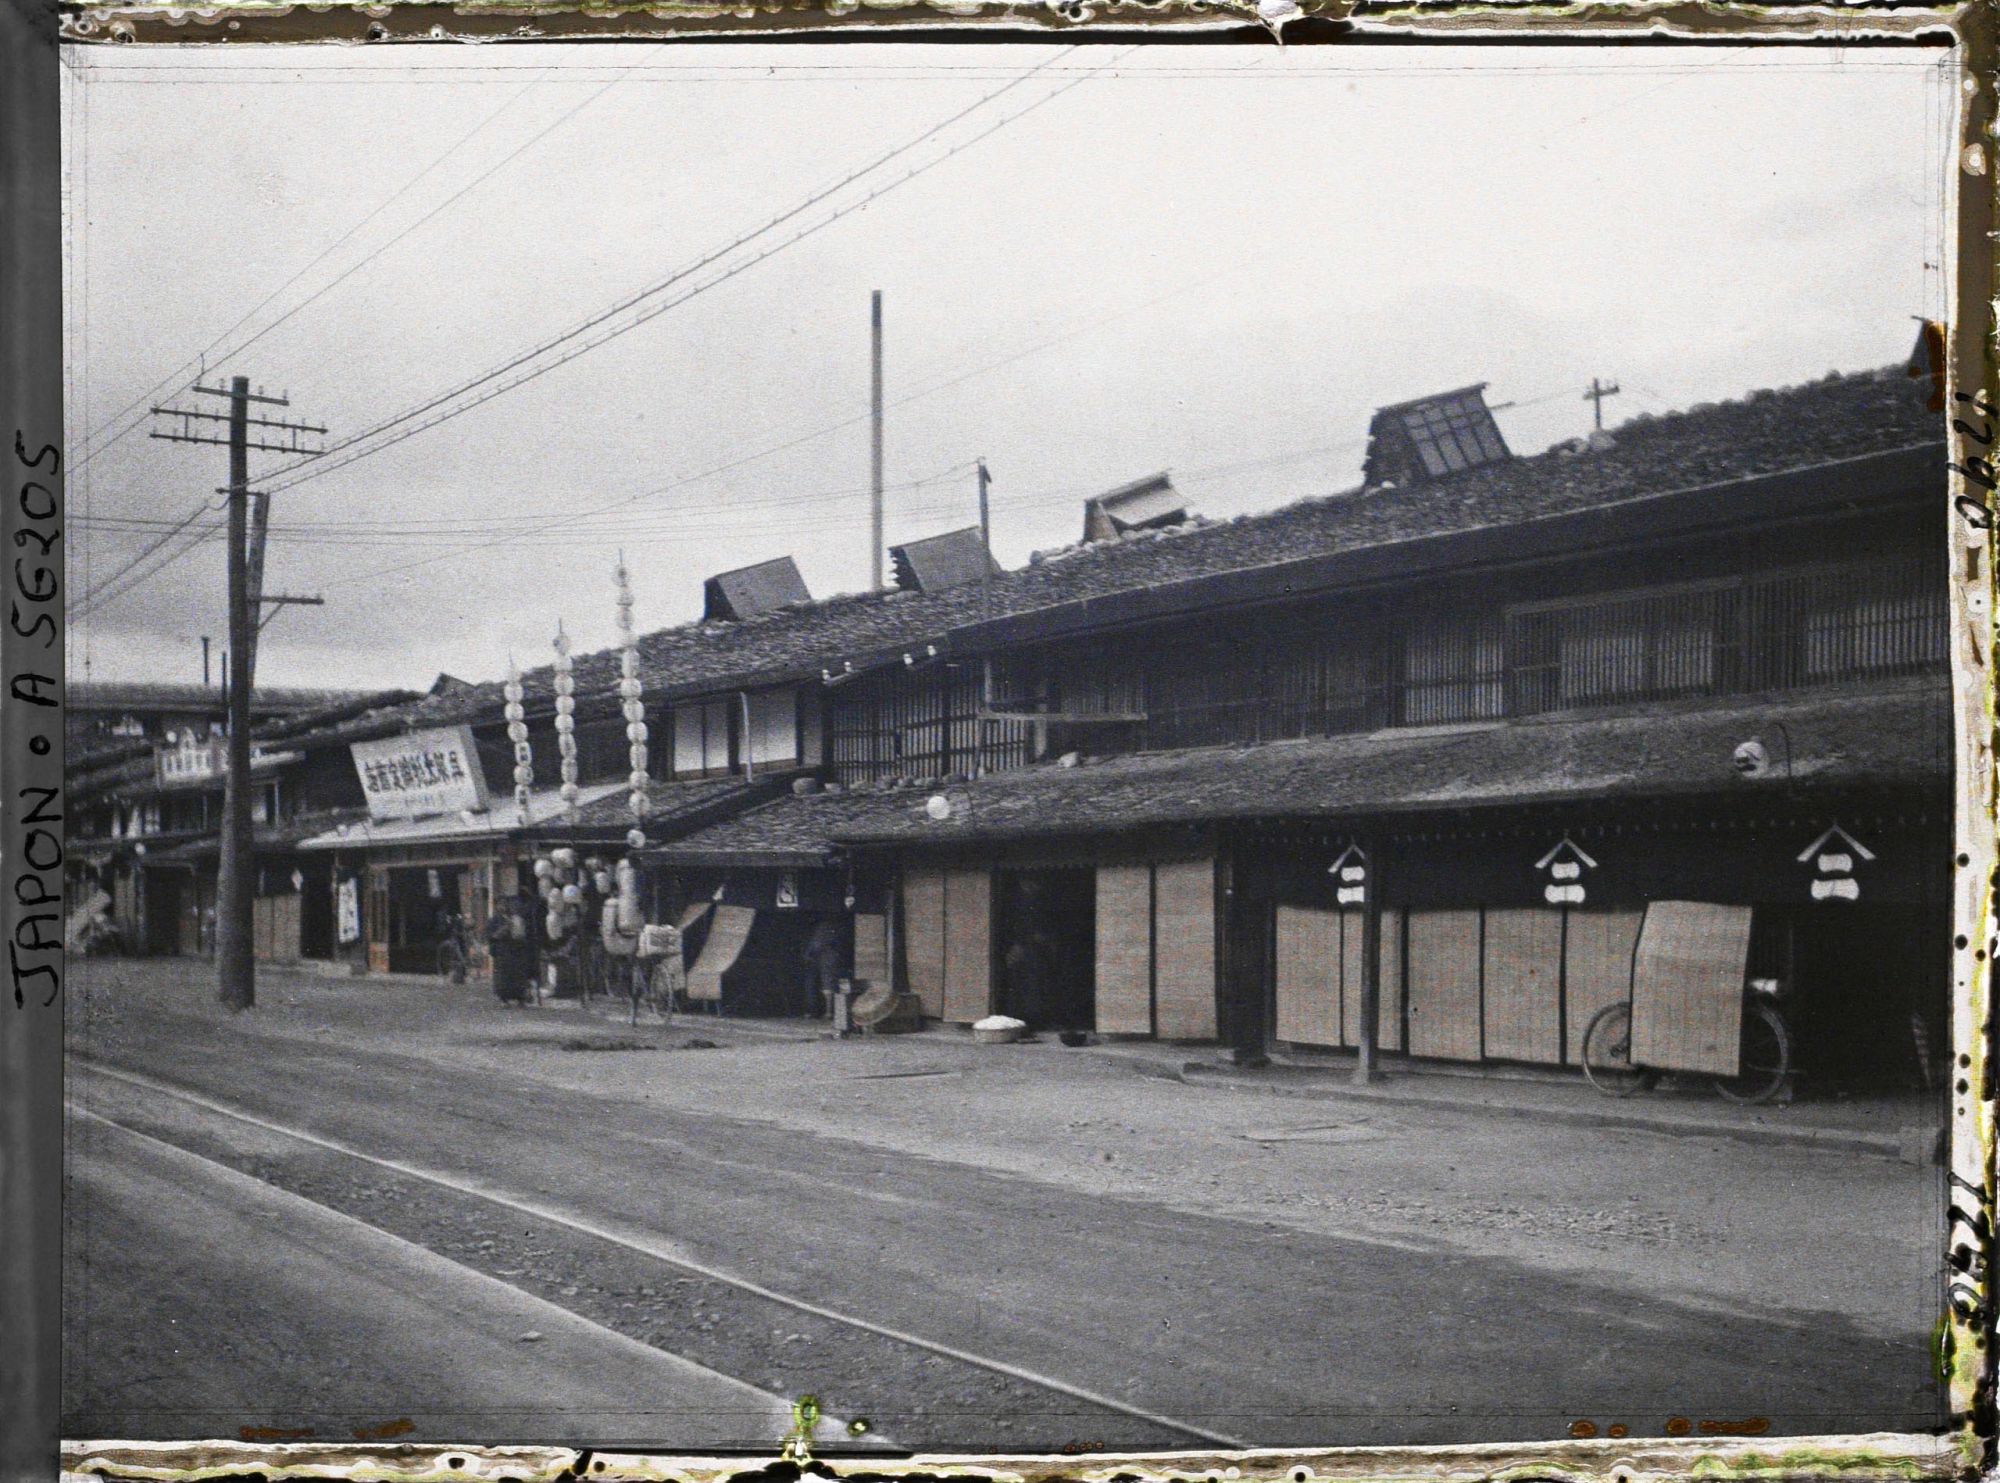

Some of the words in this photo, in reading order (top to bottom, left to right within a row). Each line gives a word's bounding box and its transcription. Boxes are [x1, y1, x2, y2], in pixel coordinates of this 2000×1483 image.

[11, 429, 61, 649] 56205
[10, 672, 59, 707] A
[9, 787, 63, 1010] JAPON
